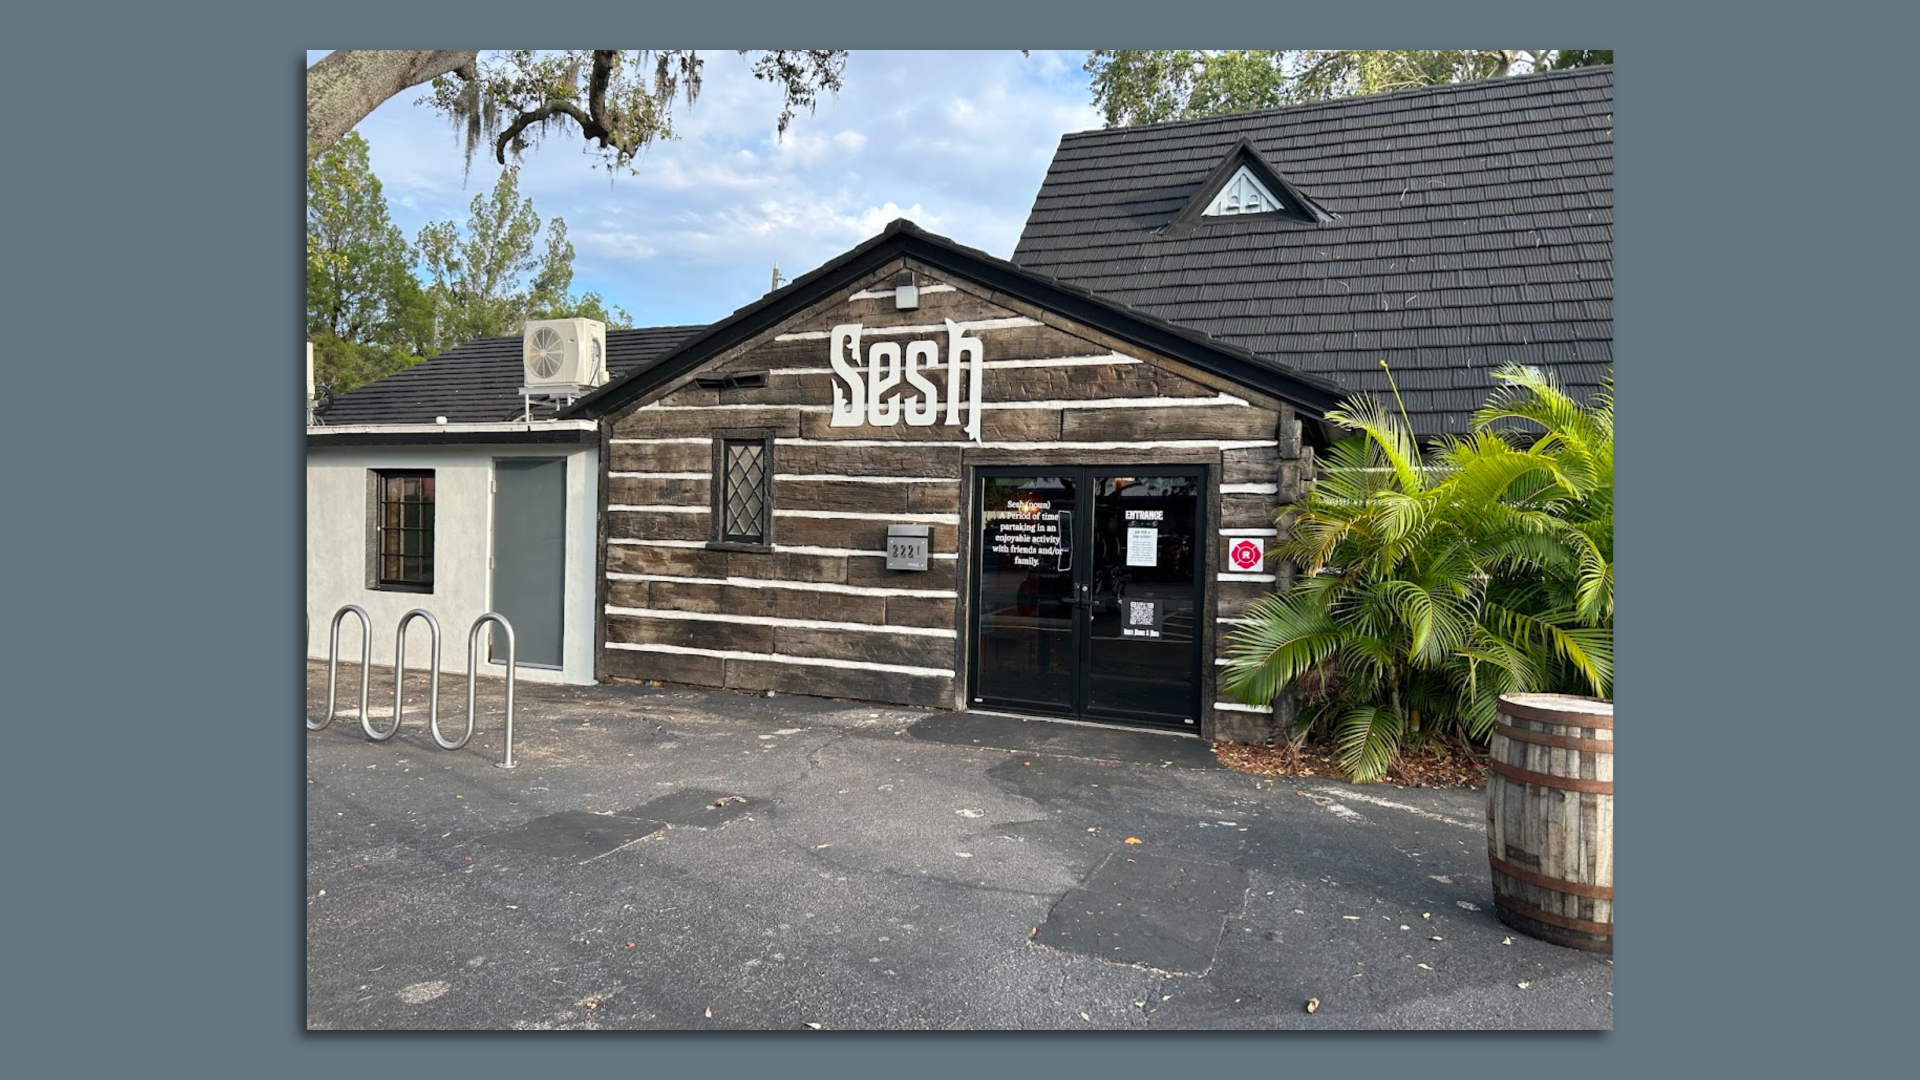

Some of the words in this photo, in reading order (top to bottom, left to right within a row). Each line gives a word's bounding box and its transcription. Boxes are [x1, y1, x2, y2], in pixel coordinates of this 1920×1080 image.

[830, 318, 983, 447] Sesh
[1007, 500, 1024, 508] Sesh
[1027, 501, 1051, 510] (noun)
[1007, 512, 1031, 520] Period
[1032, 512, 1041, 520] of
[1125, 510, 1164, 521] ENTRANCE
[1000, 523, 1036, 533] partaking
[1037, 524, 1045, 532] in
[995, 534, 1031, 543] enjoyable
[1032, 535, 1060, 545] activity
[892, 544, 920, 559] 2221
[992, 544, 1009, 553] with
[1010, 545, 1037, 554] friends
[1038, 546, 1063, 555] and/or
[1242, 551, 1251, 560] R
[1014, 556, 1039, 566] family.
